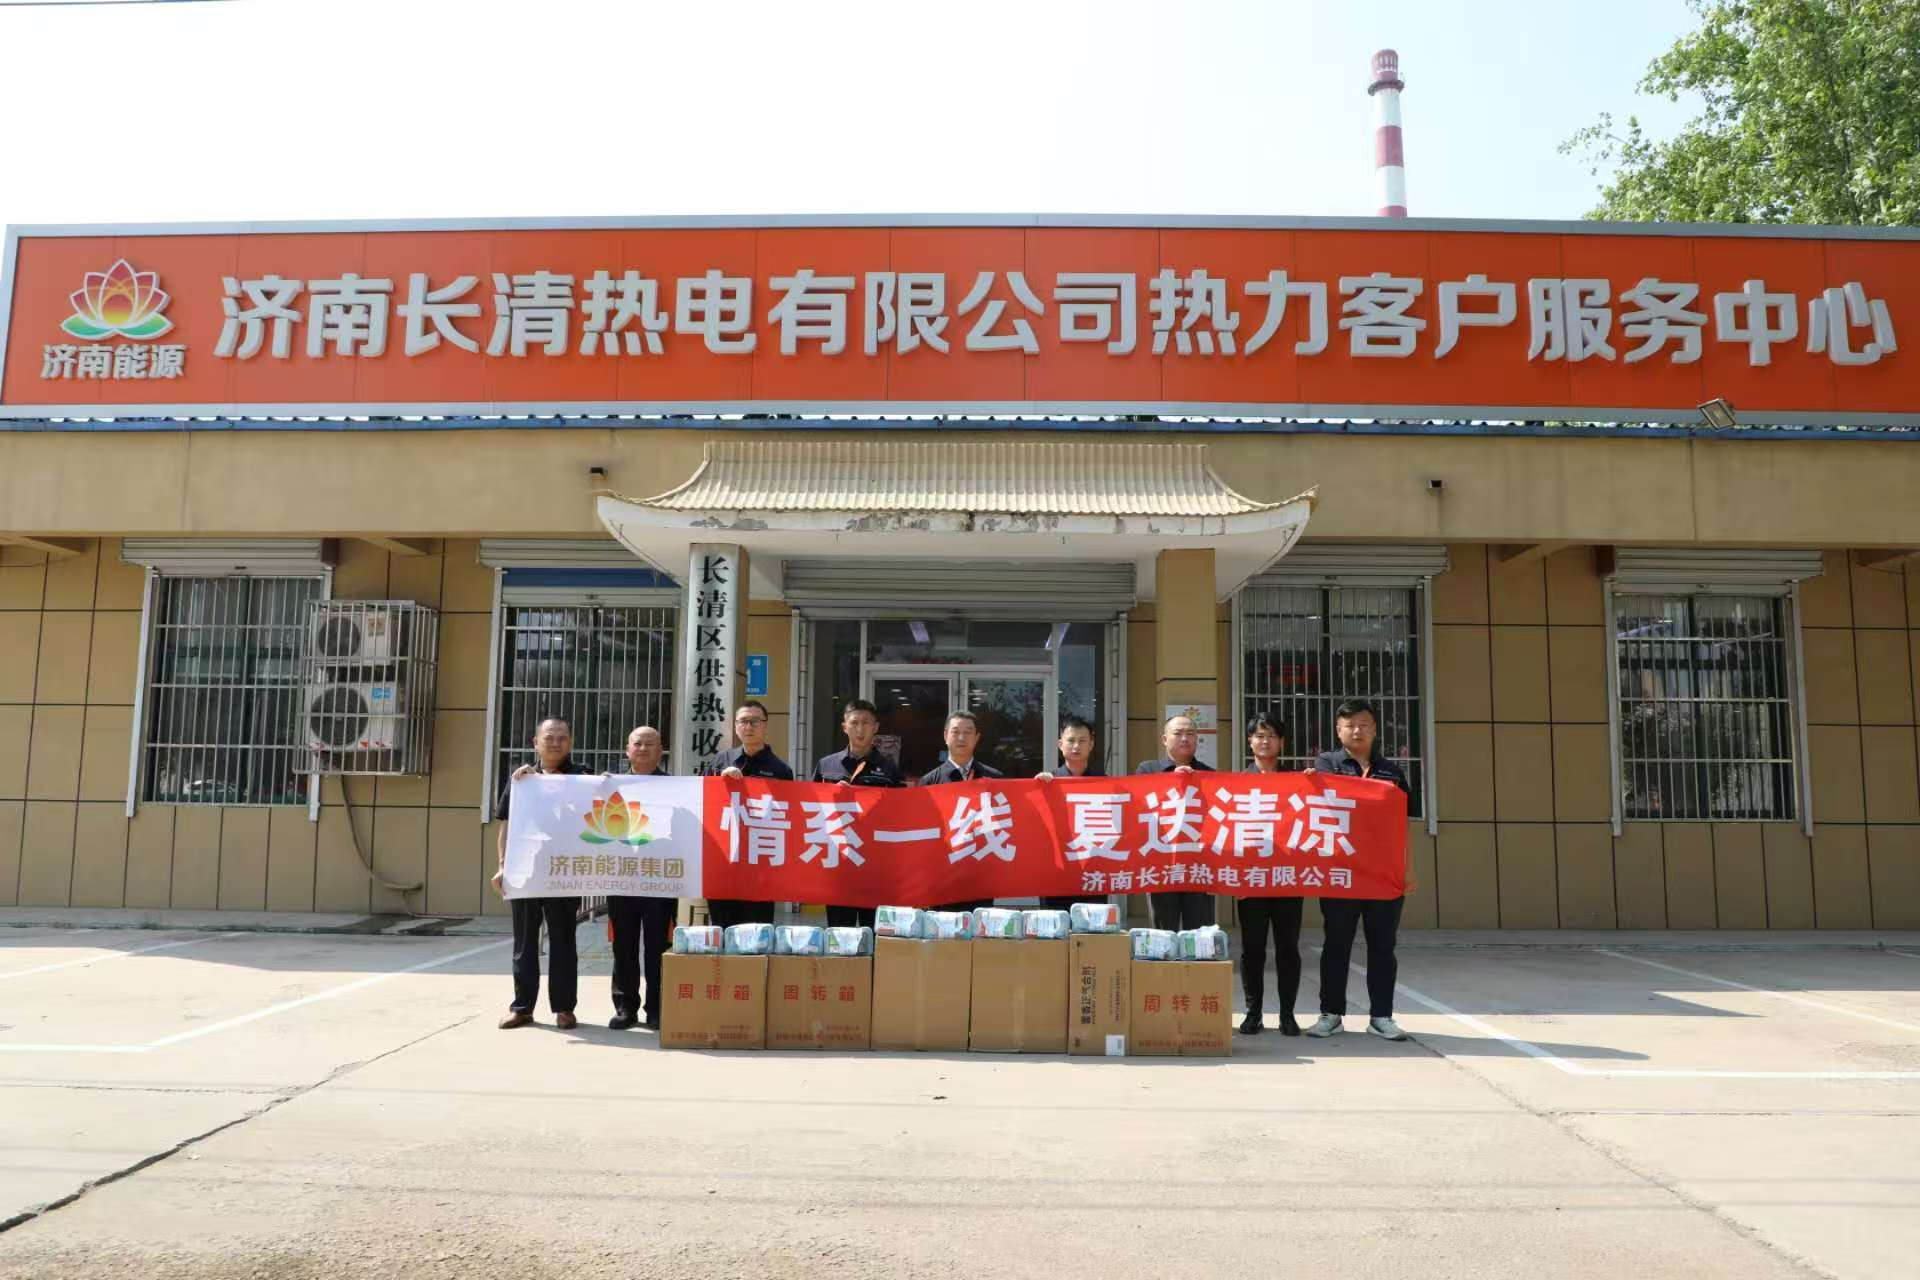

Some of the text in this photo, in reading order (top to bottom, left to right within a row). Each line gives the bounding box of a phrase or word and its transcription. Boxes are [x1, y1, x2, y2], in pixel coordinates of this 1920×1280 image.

[213, 268, 1897, 366] 济南长清热电有限公司热力客户服务中心
[41, 343, 187, 381] 济南能源
[692, 556, 729, 776] 长清区供热收
[720, 787, 1356, 868] 情系一线 夏送清凉
[548, 854, 685, 879] 济南能源集团
[1081, 863, 1354, 893] 济南长清热电有限公司
[586, 881, 637, 891] ENERGY
[640, 881, 684, 893] GROUP
[783, 984, 856, 1002] 周转箱
[1143, 993, 1220, 1015] 周转箱
